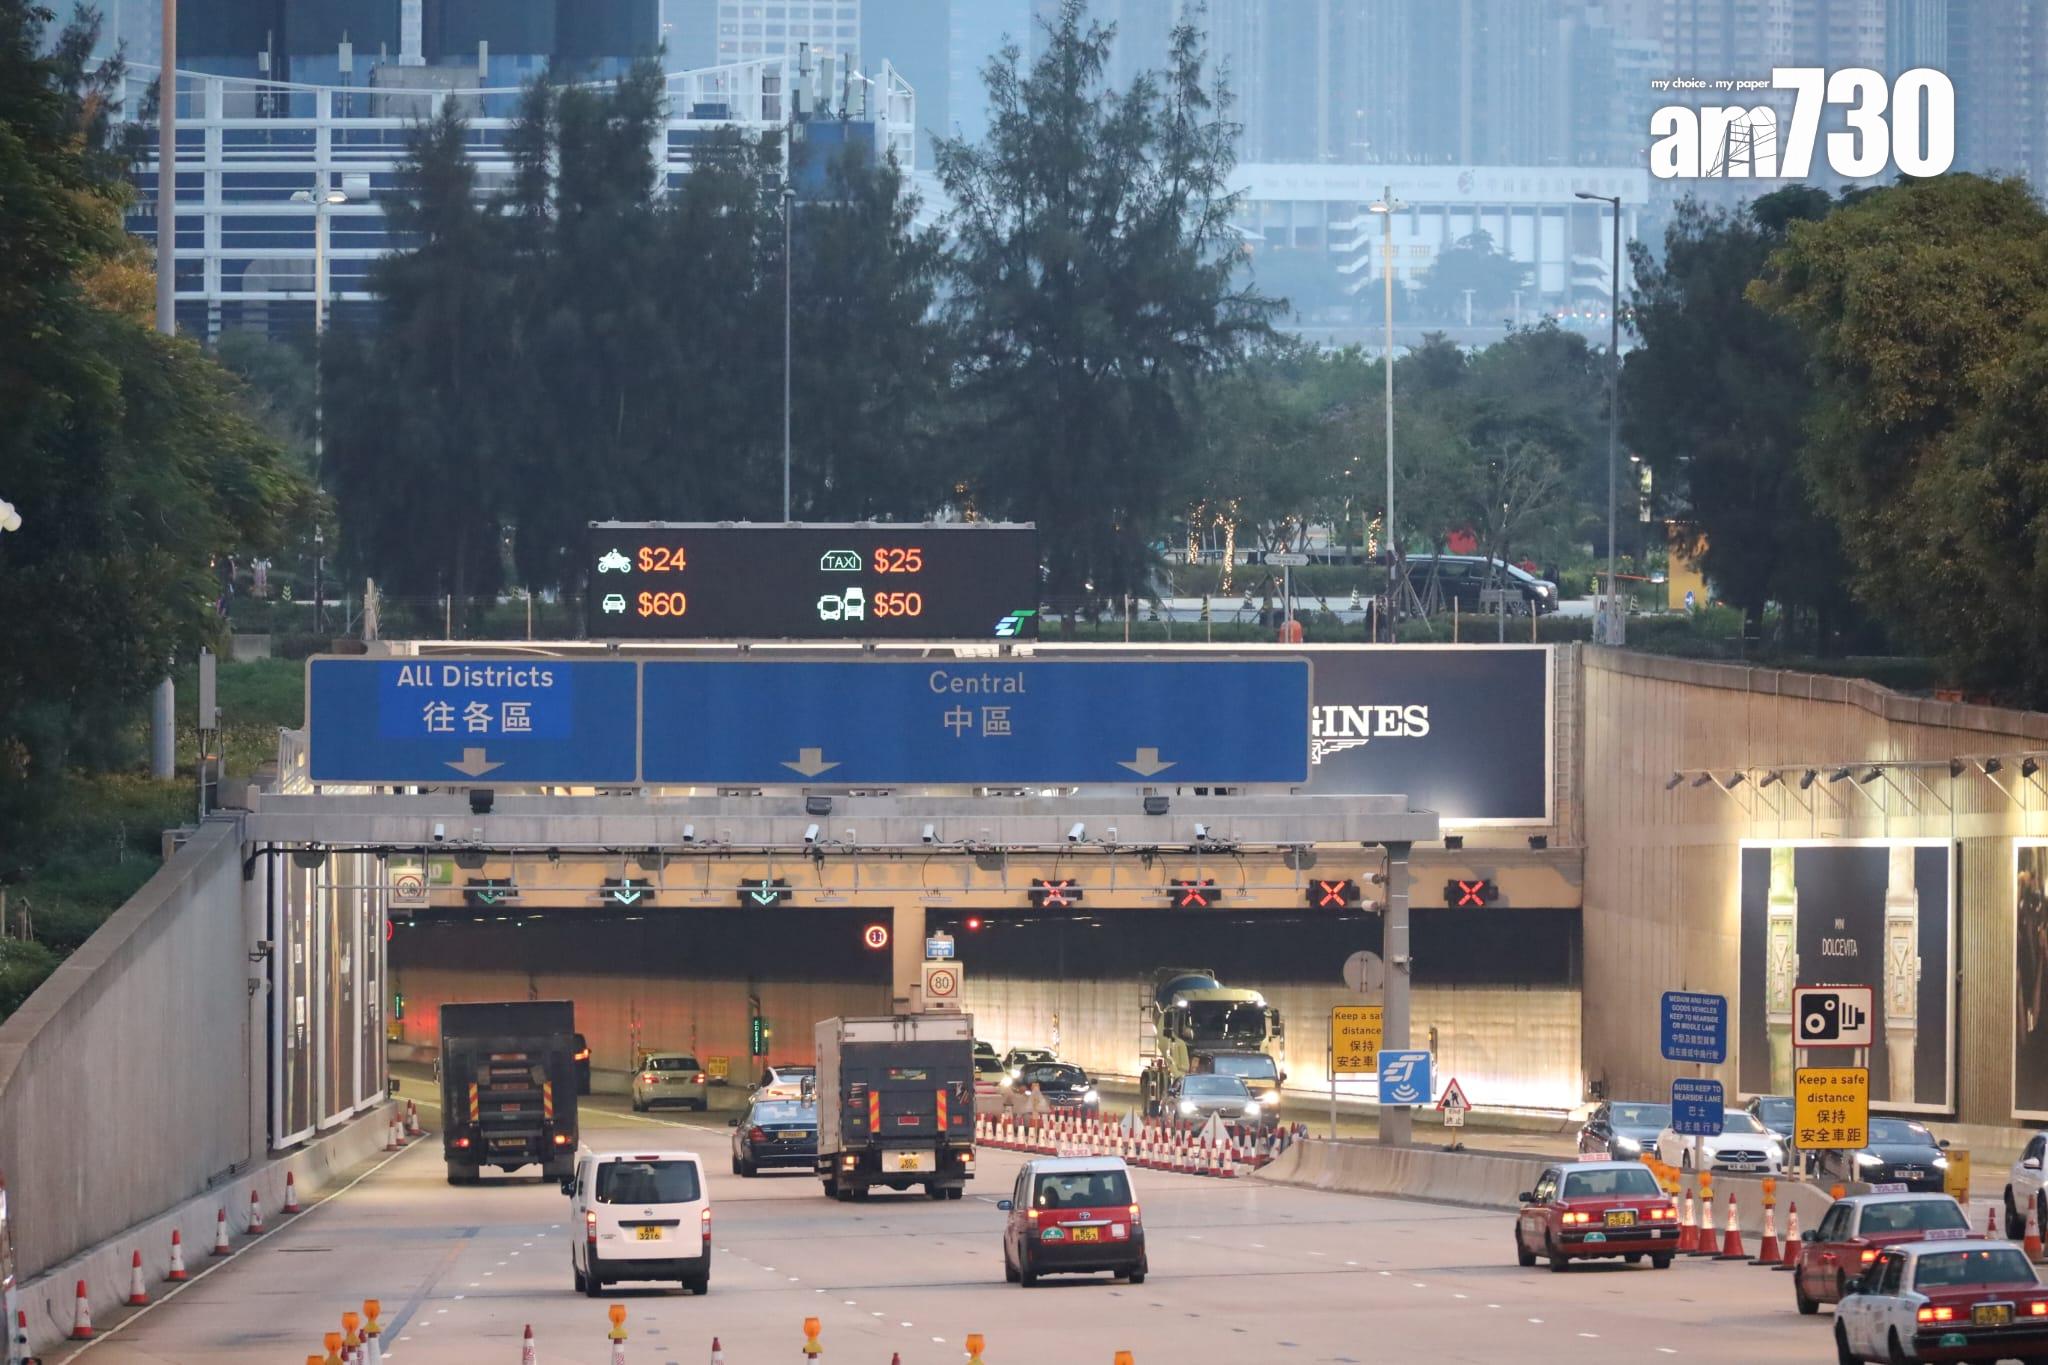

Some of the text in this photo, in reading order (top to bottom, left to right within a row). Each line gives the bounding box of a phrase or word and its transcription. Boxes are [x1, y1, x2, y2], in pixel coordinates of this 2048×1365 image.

[638, 546, 687, 573] $24
[826, 547, 922, 574] TAXI $25
[638, 591, 687, 618] $60
[873, 592, 922, 618] $50
[397, 665, 554, 688] All Districts
[929, 670, 1026, 694] Central
[423, 700, 533, 733] 往各區
[944, 704, 1012, 738] 中區
[935, 976, 949, 989] 80
[1672, 1004, 1691, 1012] GOODS
[1335, 1011, 1358, 1021] Keep
[1342, 1026, 1382, 1035] distance
[1701, 1024, 1716, 1032] LANE
[1350, 1040, 1374, 1052] 保持
[1799, 1074, 1865, 1086] Keep a safe
[1674, 1083, 1721, 1093] BUSES KEEP TO
[1674, 1093, 1721, 1103] NEARSIDE LANE
[1807, 1093, 1855, 1102] distance
[1817, 1109, 1846, 1124] 保持
[1800, 1128, 1862, 1143] 安全車距
